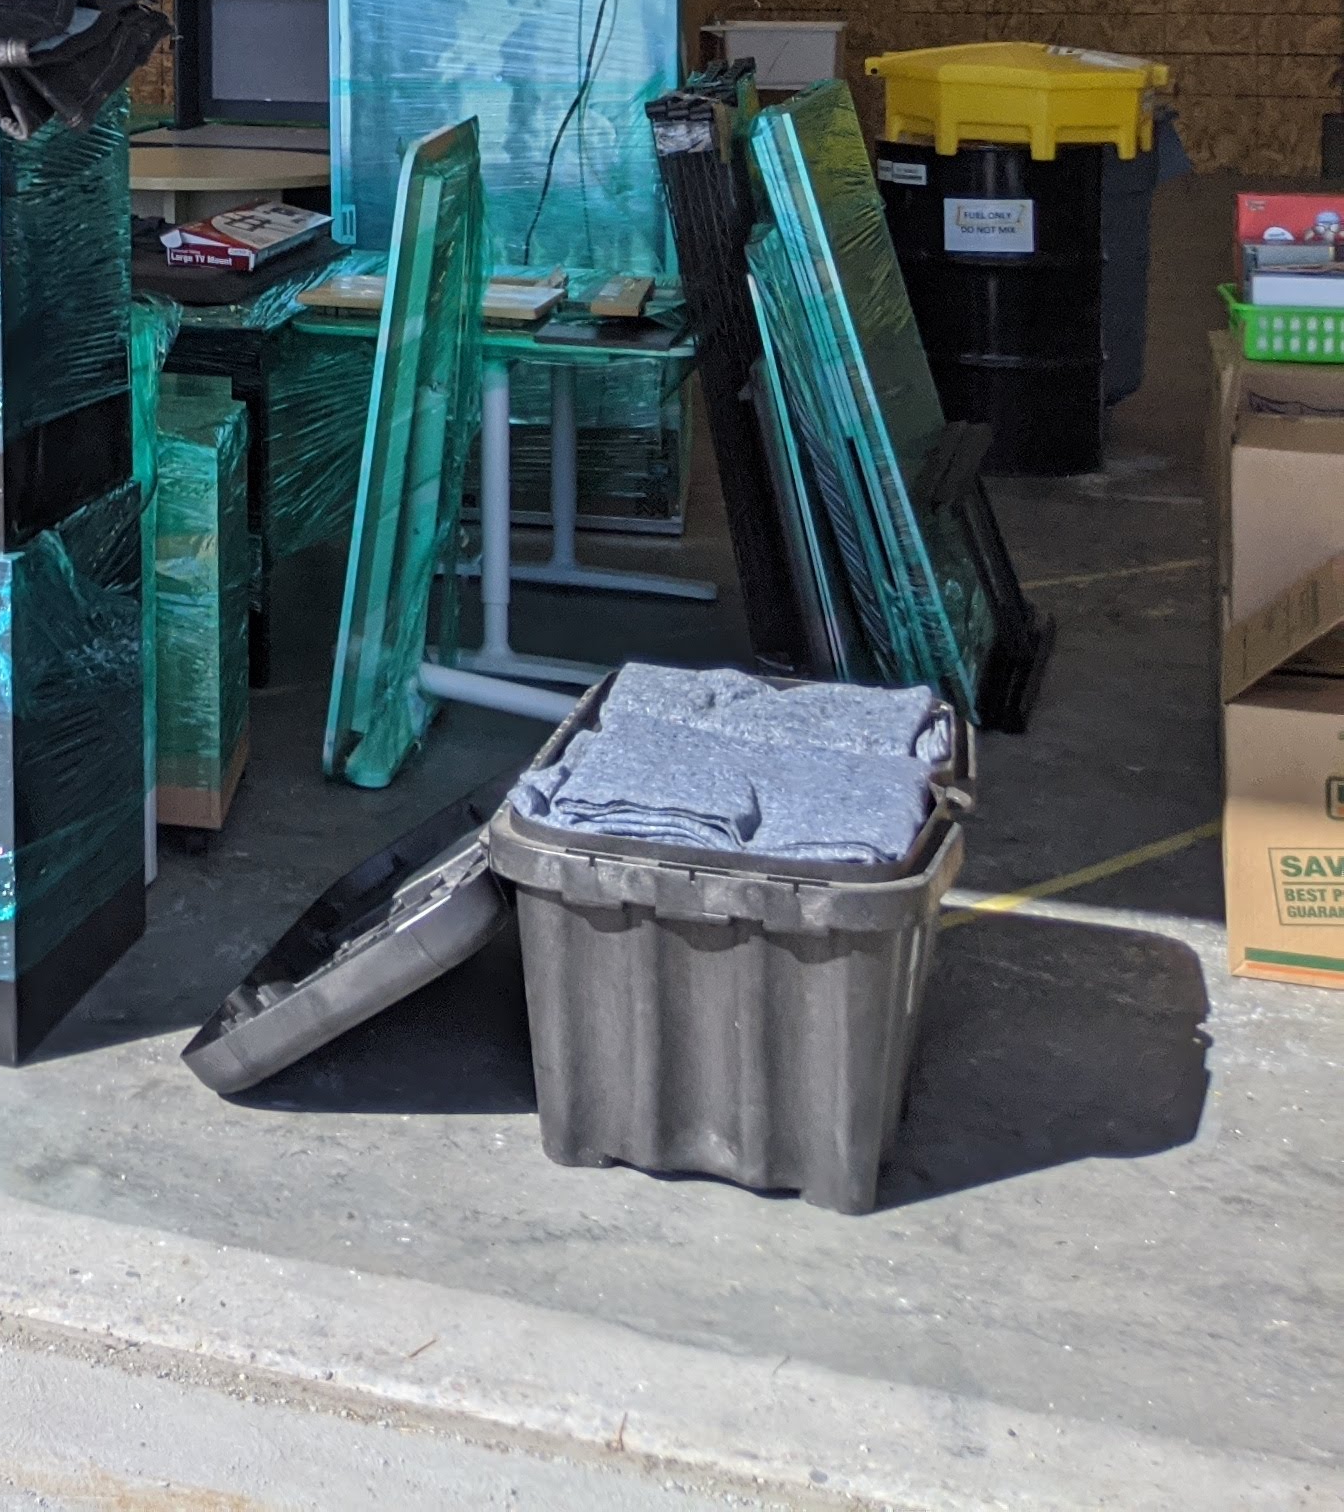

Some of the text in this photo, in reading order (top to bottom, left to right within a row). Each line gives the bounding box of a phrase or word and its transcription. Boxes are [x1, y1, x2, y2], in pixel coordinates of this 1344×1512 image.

[963, 211, 1011, 219] FUEL ONLY
[960, 226, 1016, 234] DO NOT MIX
[171, 252, 232, 266] Large TV Mount
[1284, 888, 1344, 902] BEST P
